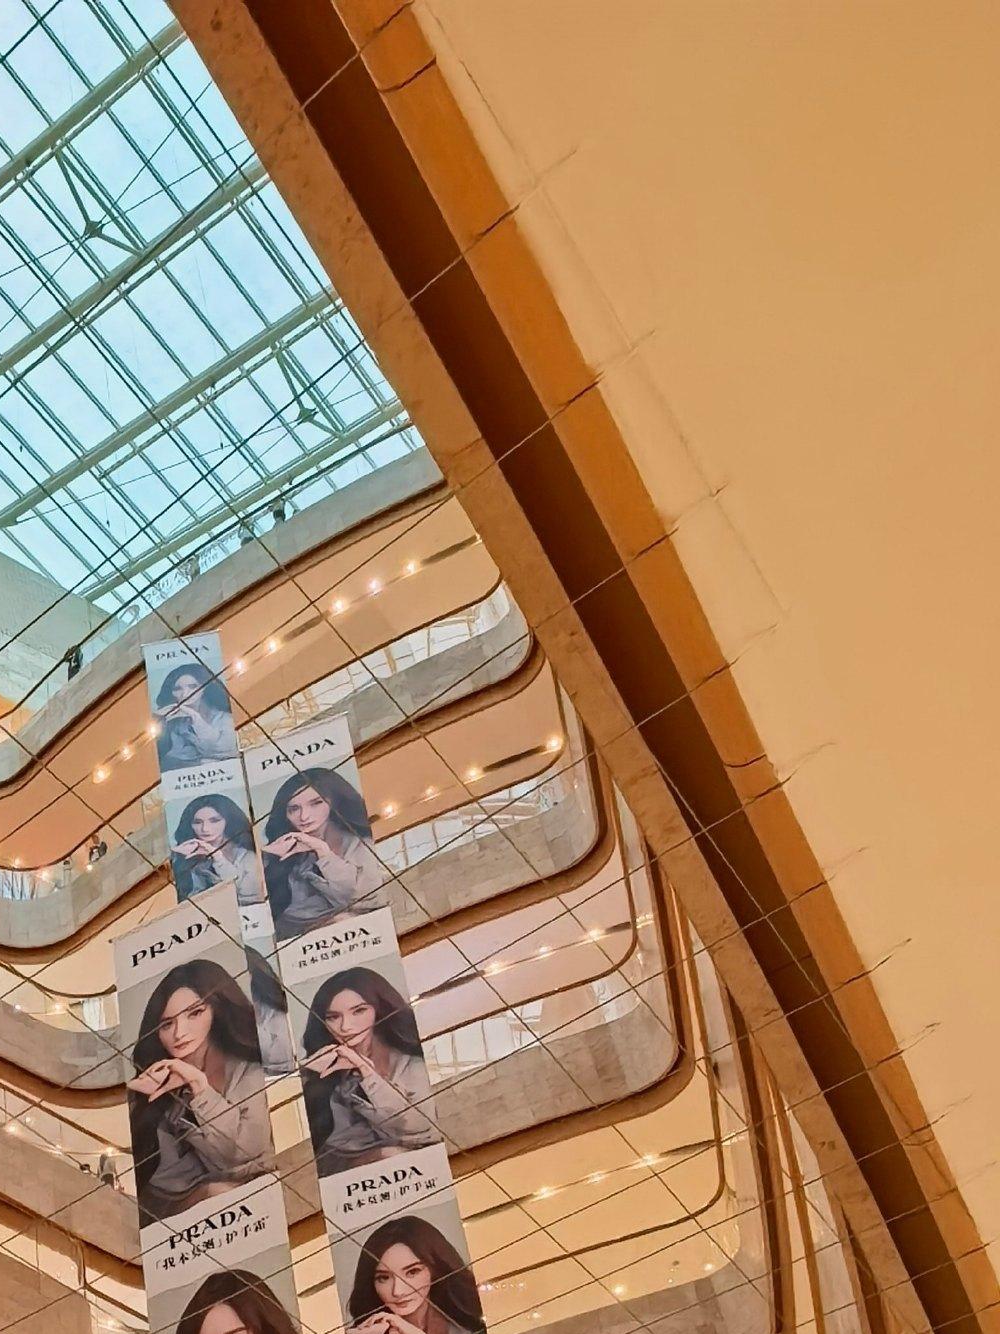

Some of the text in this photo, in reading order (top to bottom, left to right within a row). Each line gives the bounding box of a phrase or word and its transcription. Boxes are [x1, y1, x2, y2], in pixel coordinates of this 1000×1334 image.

[156, 644, 210, 662] PRADA
[261, 738, 337, 771] PRADA
[178, 768, 225, 783] PRADA
[131, 916, 221, 968] PRADA
[302, 927, 370, 955] PRADA
[346, 1165, 423, 1197] PRADA
[168, 1205, 253, 1250] PRADA
